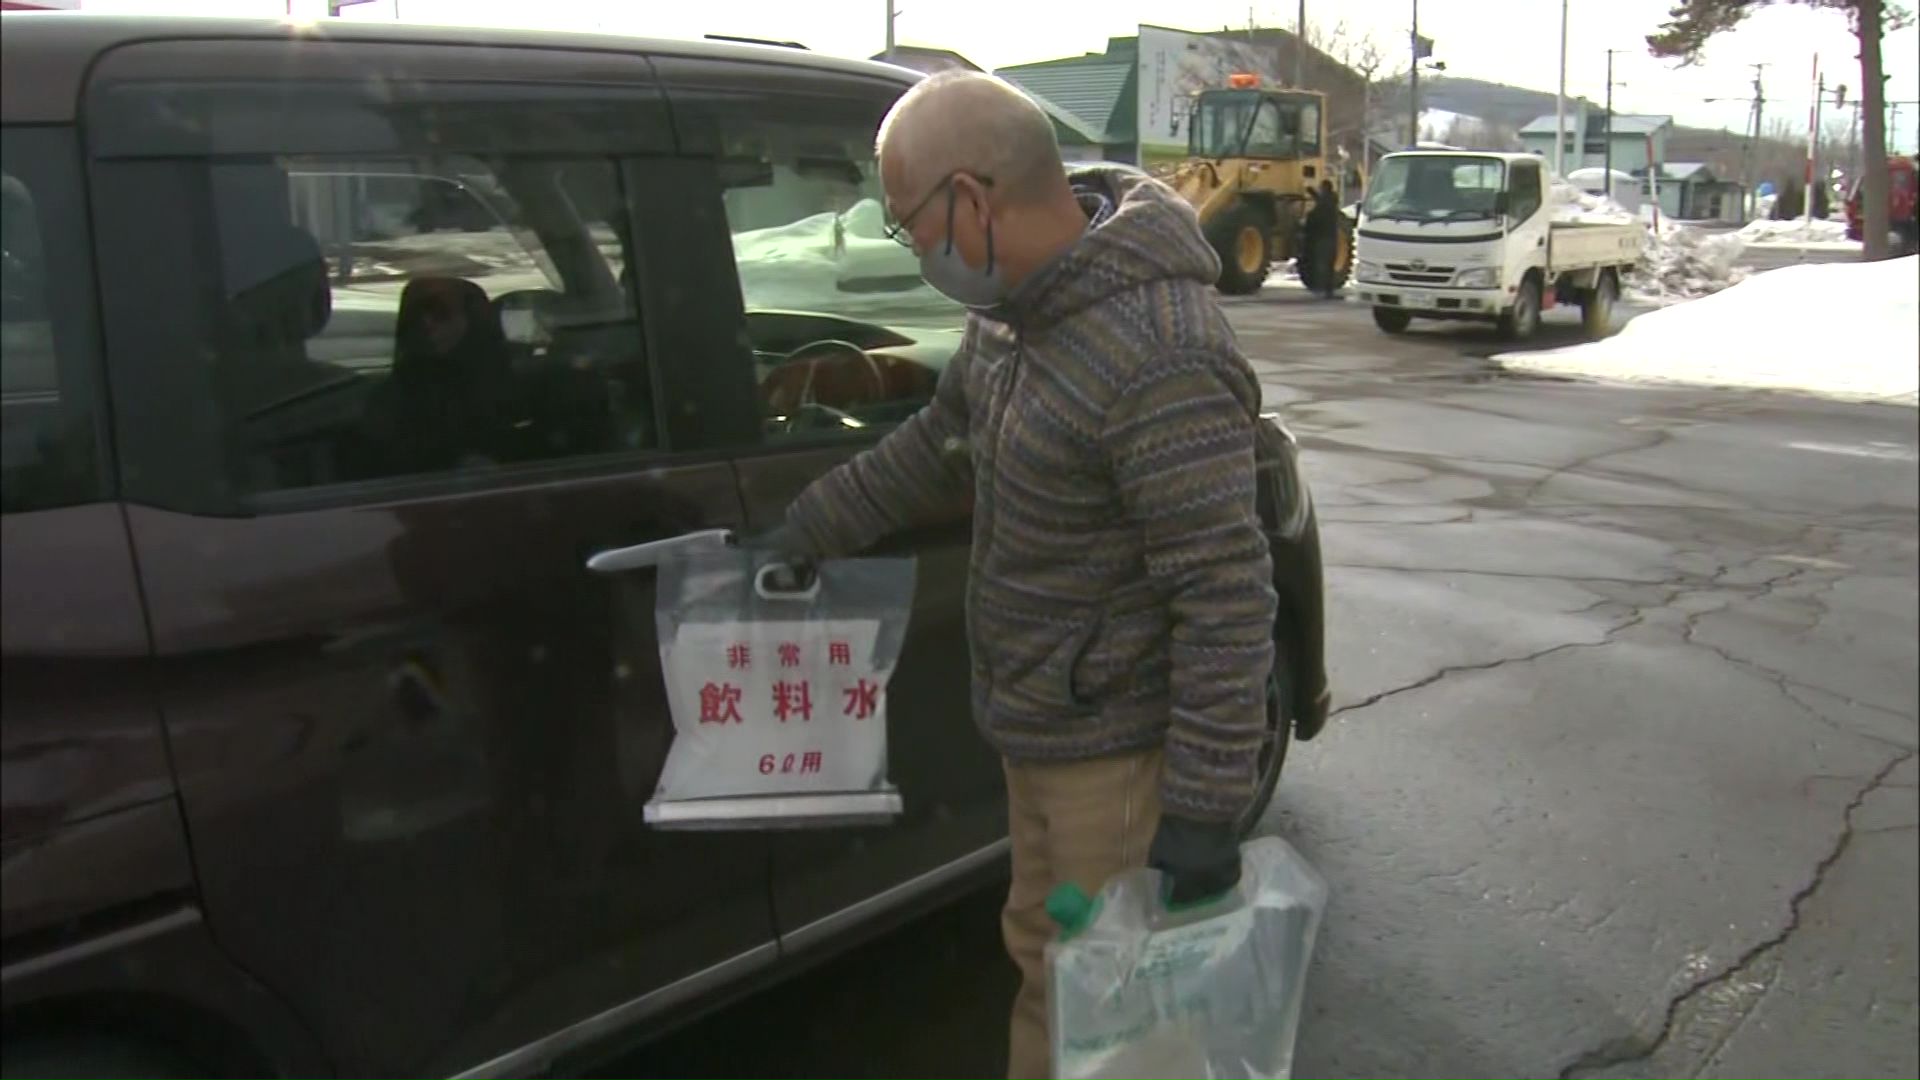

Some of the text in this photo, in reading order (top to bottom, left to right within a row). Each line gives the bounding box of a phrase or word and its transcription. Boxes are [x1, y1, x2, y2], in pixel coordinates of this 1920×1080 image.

[726, 642, 851, 669] 非常用
[699, 679, 878, 725] 飲料水
